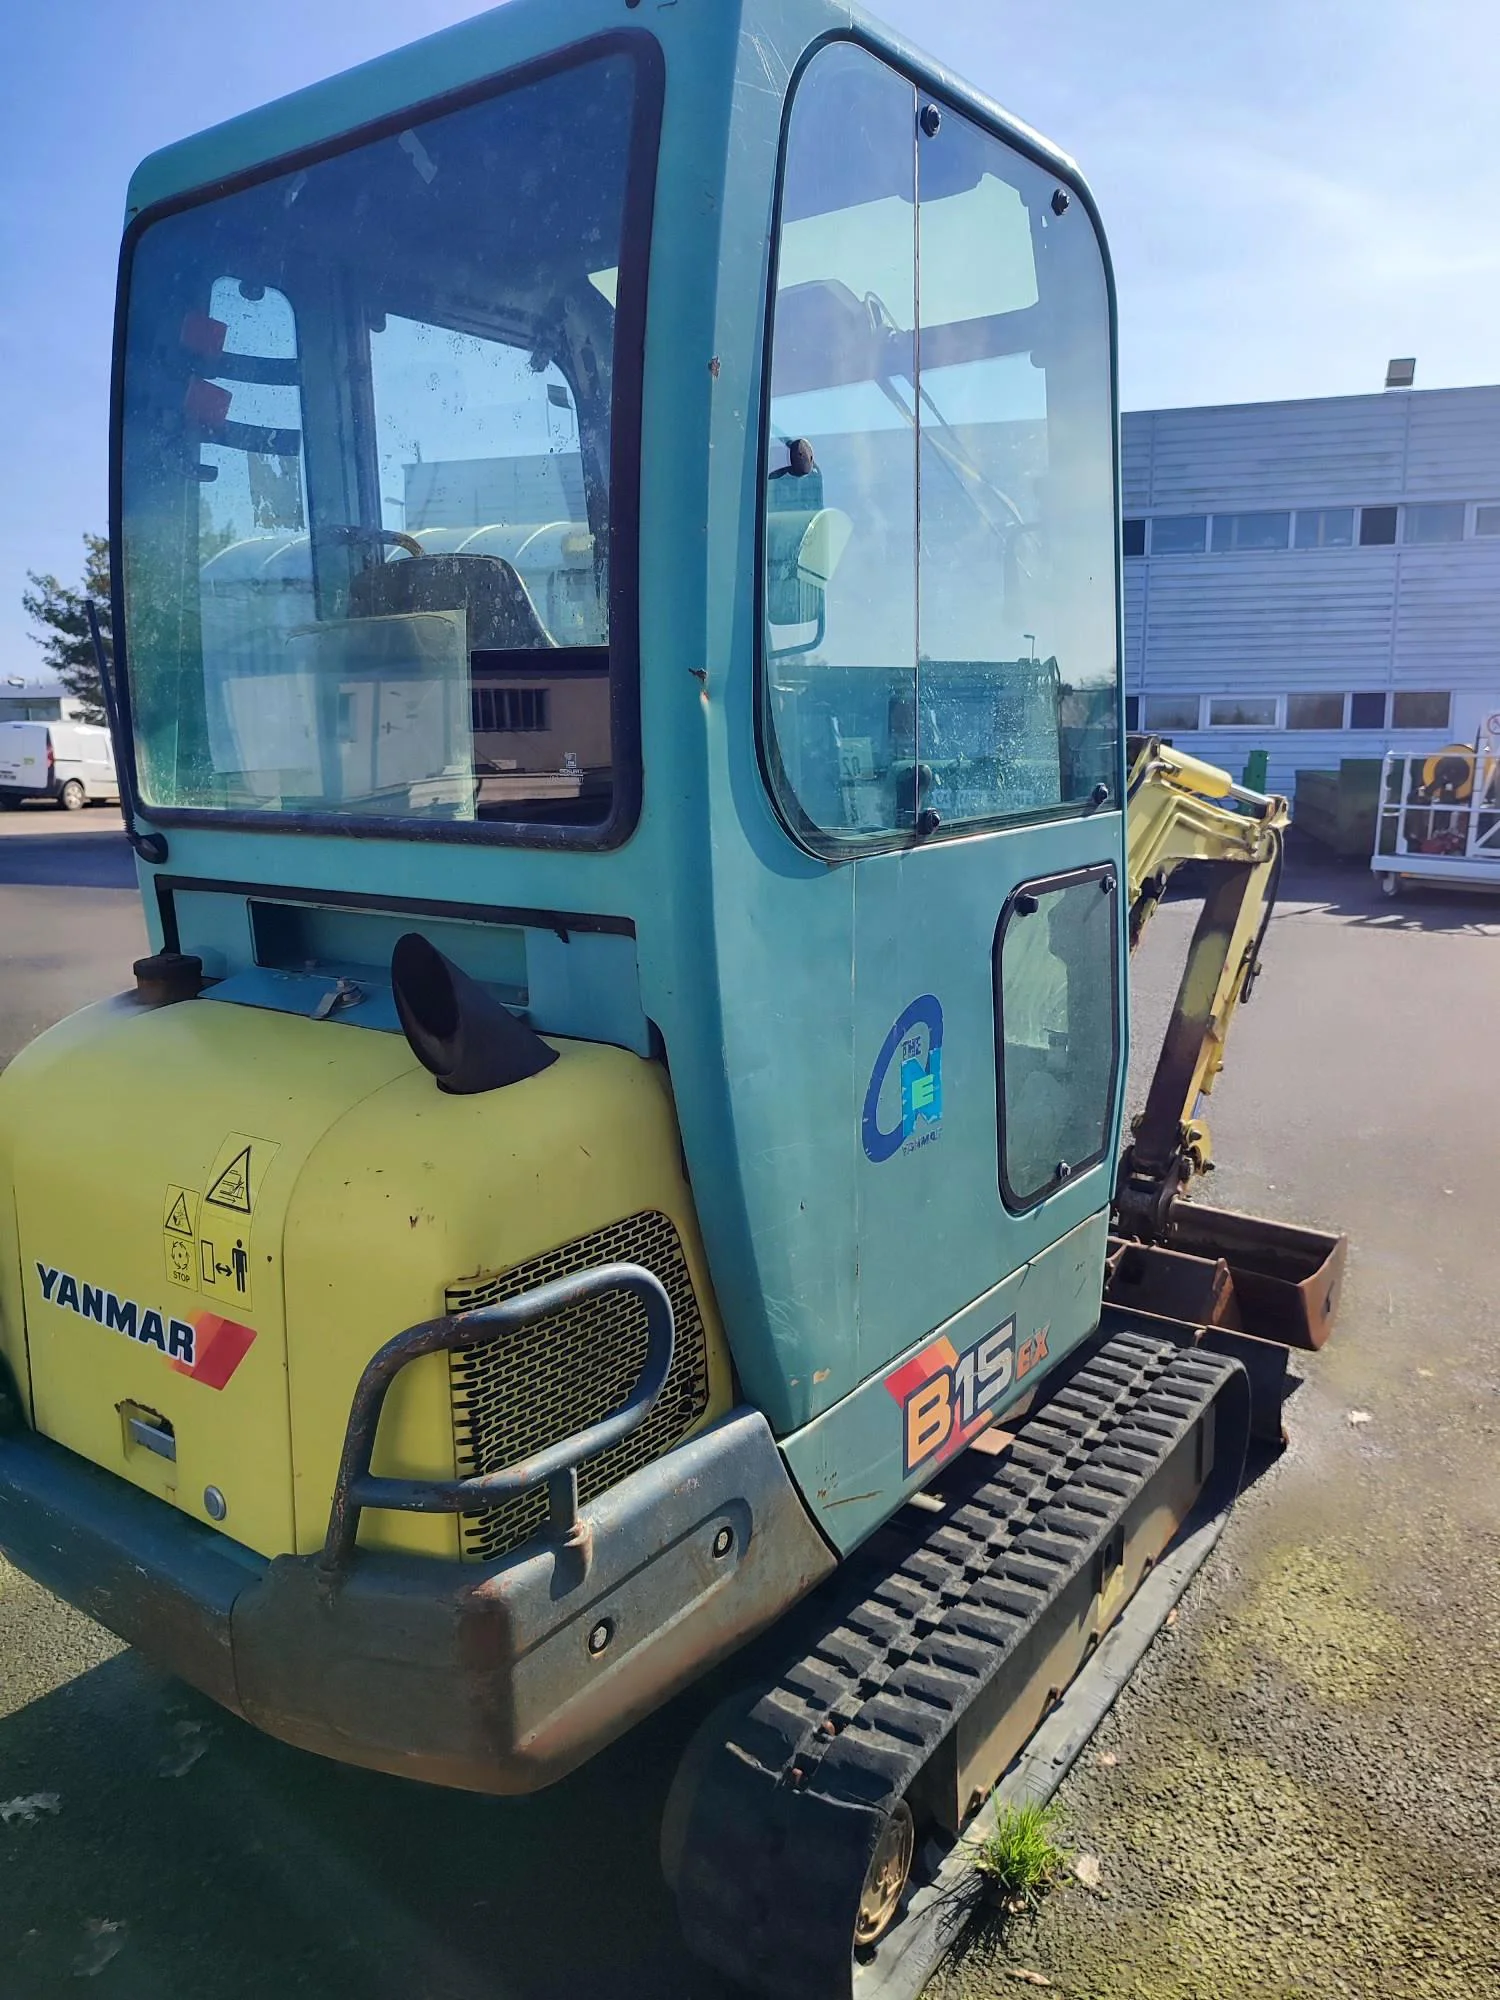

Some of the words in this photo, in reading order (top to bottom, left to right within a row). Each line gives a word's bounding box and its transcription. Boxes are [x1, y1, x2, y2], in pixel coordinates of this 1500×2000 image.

[902, 1036, 921, 1058] THE
[173, 1270, 190, 1283] STOP
[34, 1260, 196, 1367] YANMAR
[903, 1313, 1016, 1480] B15
[1016, 1324, 1050, 1382] EX
